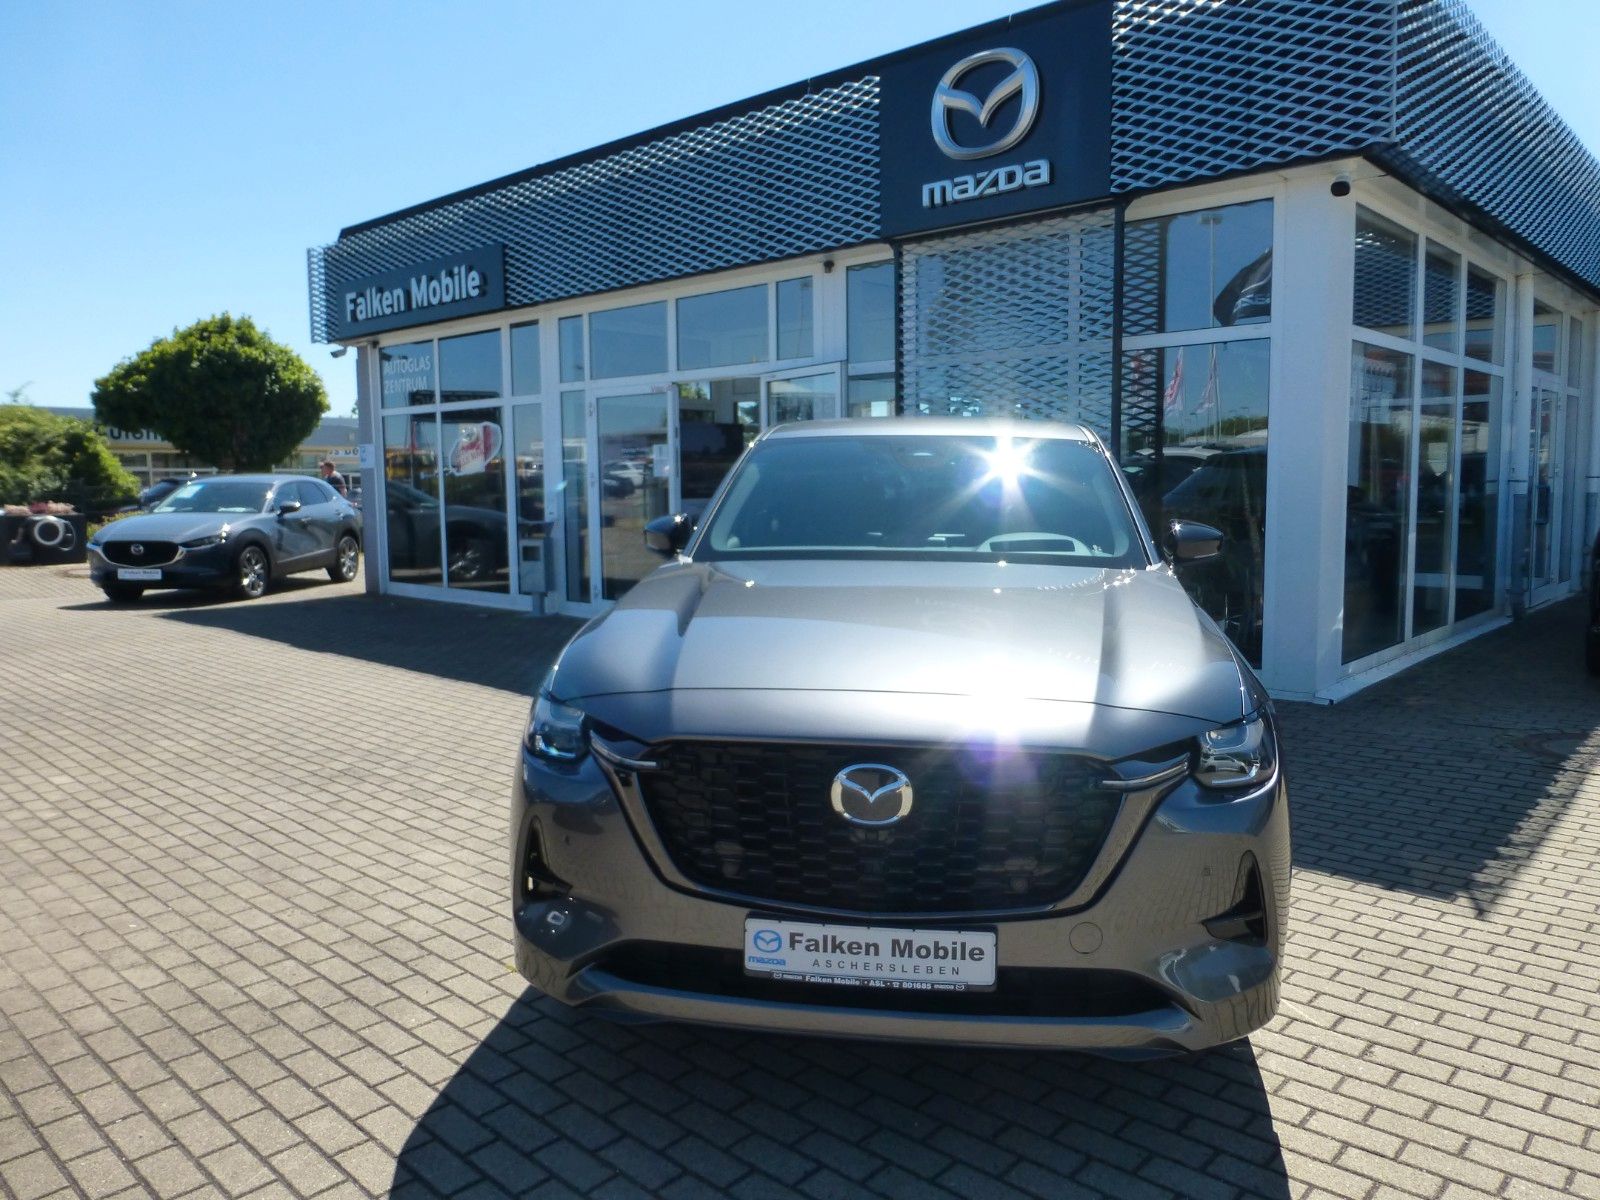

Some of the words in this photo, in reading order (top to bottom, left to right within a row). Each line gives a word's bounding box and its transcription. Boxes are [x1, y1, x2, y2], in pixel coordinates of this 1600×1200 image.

[345, 286, 405, 323] Falken
[410, 264, 480, 310] Mobile
[383, 355, 431, 376] AUTOGLAS
[384, 376, 428, 394] ZENTRUM
[789, 932, 880, 957] Falken
[891, 938, 985, 962] Mobile
[812, 959, 960, 976] ASCHERSLEBEN
[805, 975, 832, 984] Falken
